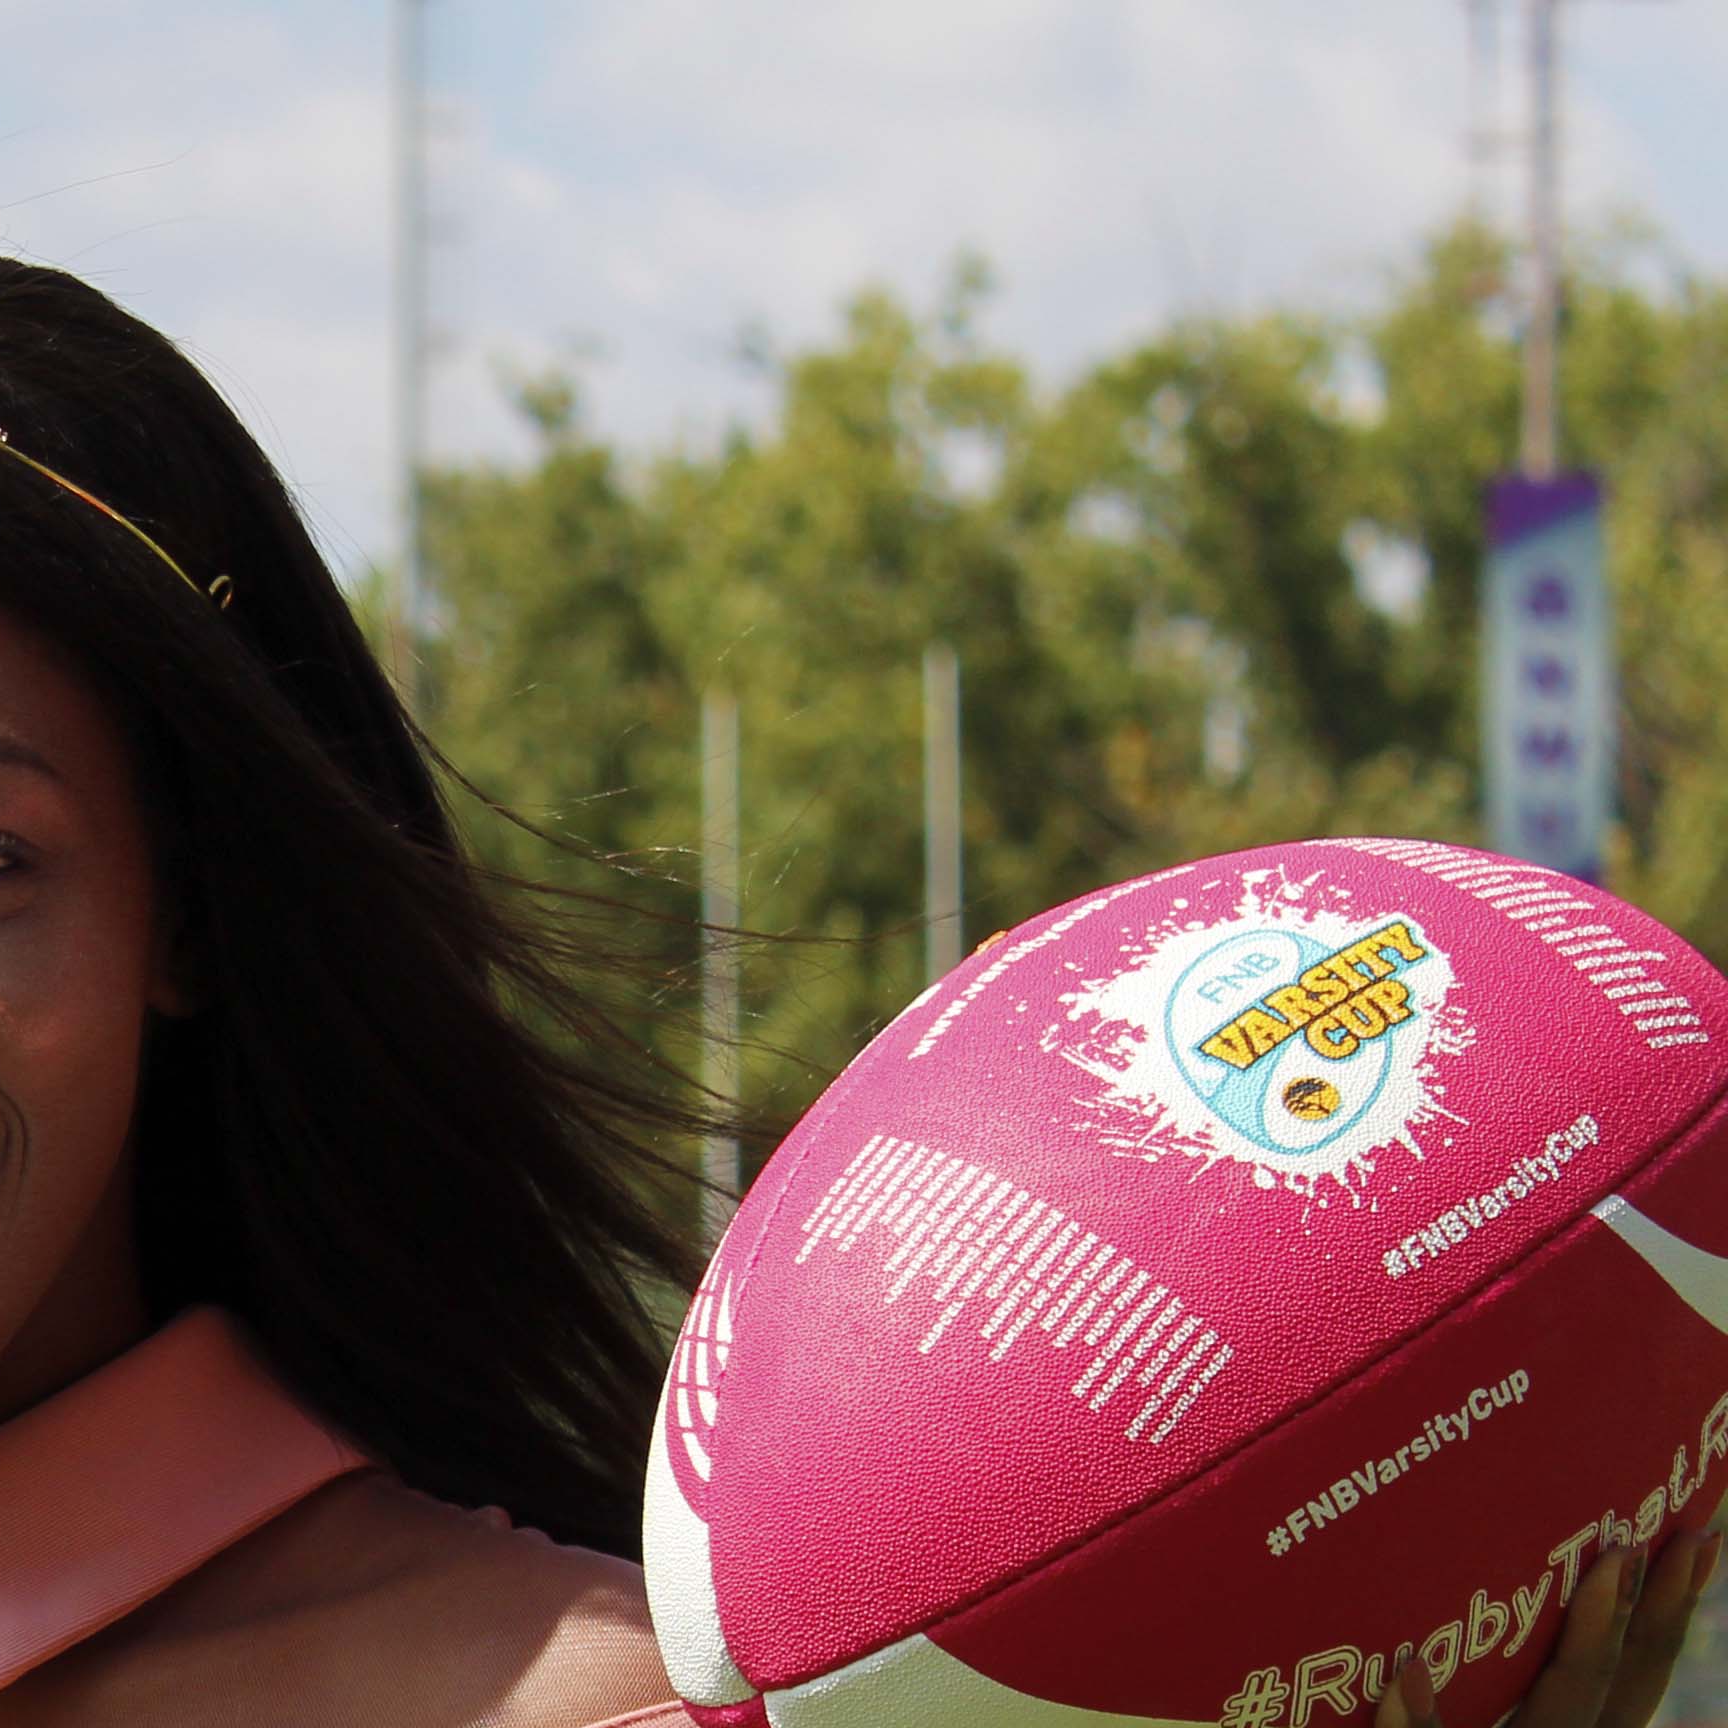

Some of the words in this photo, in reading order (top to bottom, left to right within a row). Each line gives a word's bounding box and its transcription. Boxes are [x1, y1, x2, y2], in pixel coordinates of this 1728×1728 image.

[1197, 953, 1280, 1004] FNB
[1199, 921, 1427, 1070] VARSITY
[1304, 979, 1414, 1060] CUP
[1382, 1114, 1600, 1280] #FNBVarsityCup
[1266, 1369, 1530, 1557] #FNBVarsityCup
